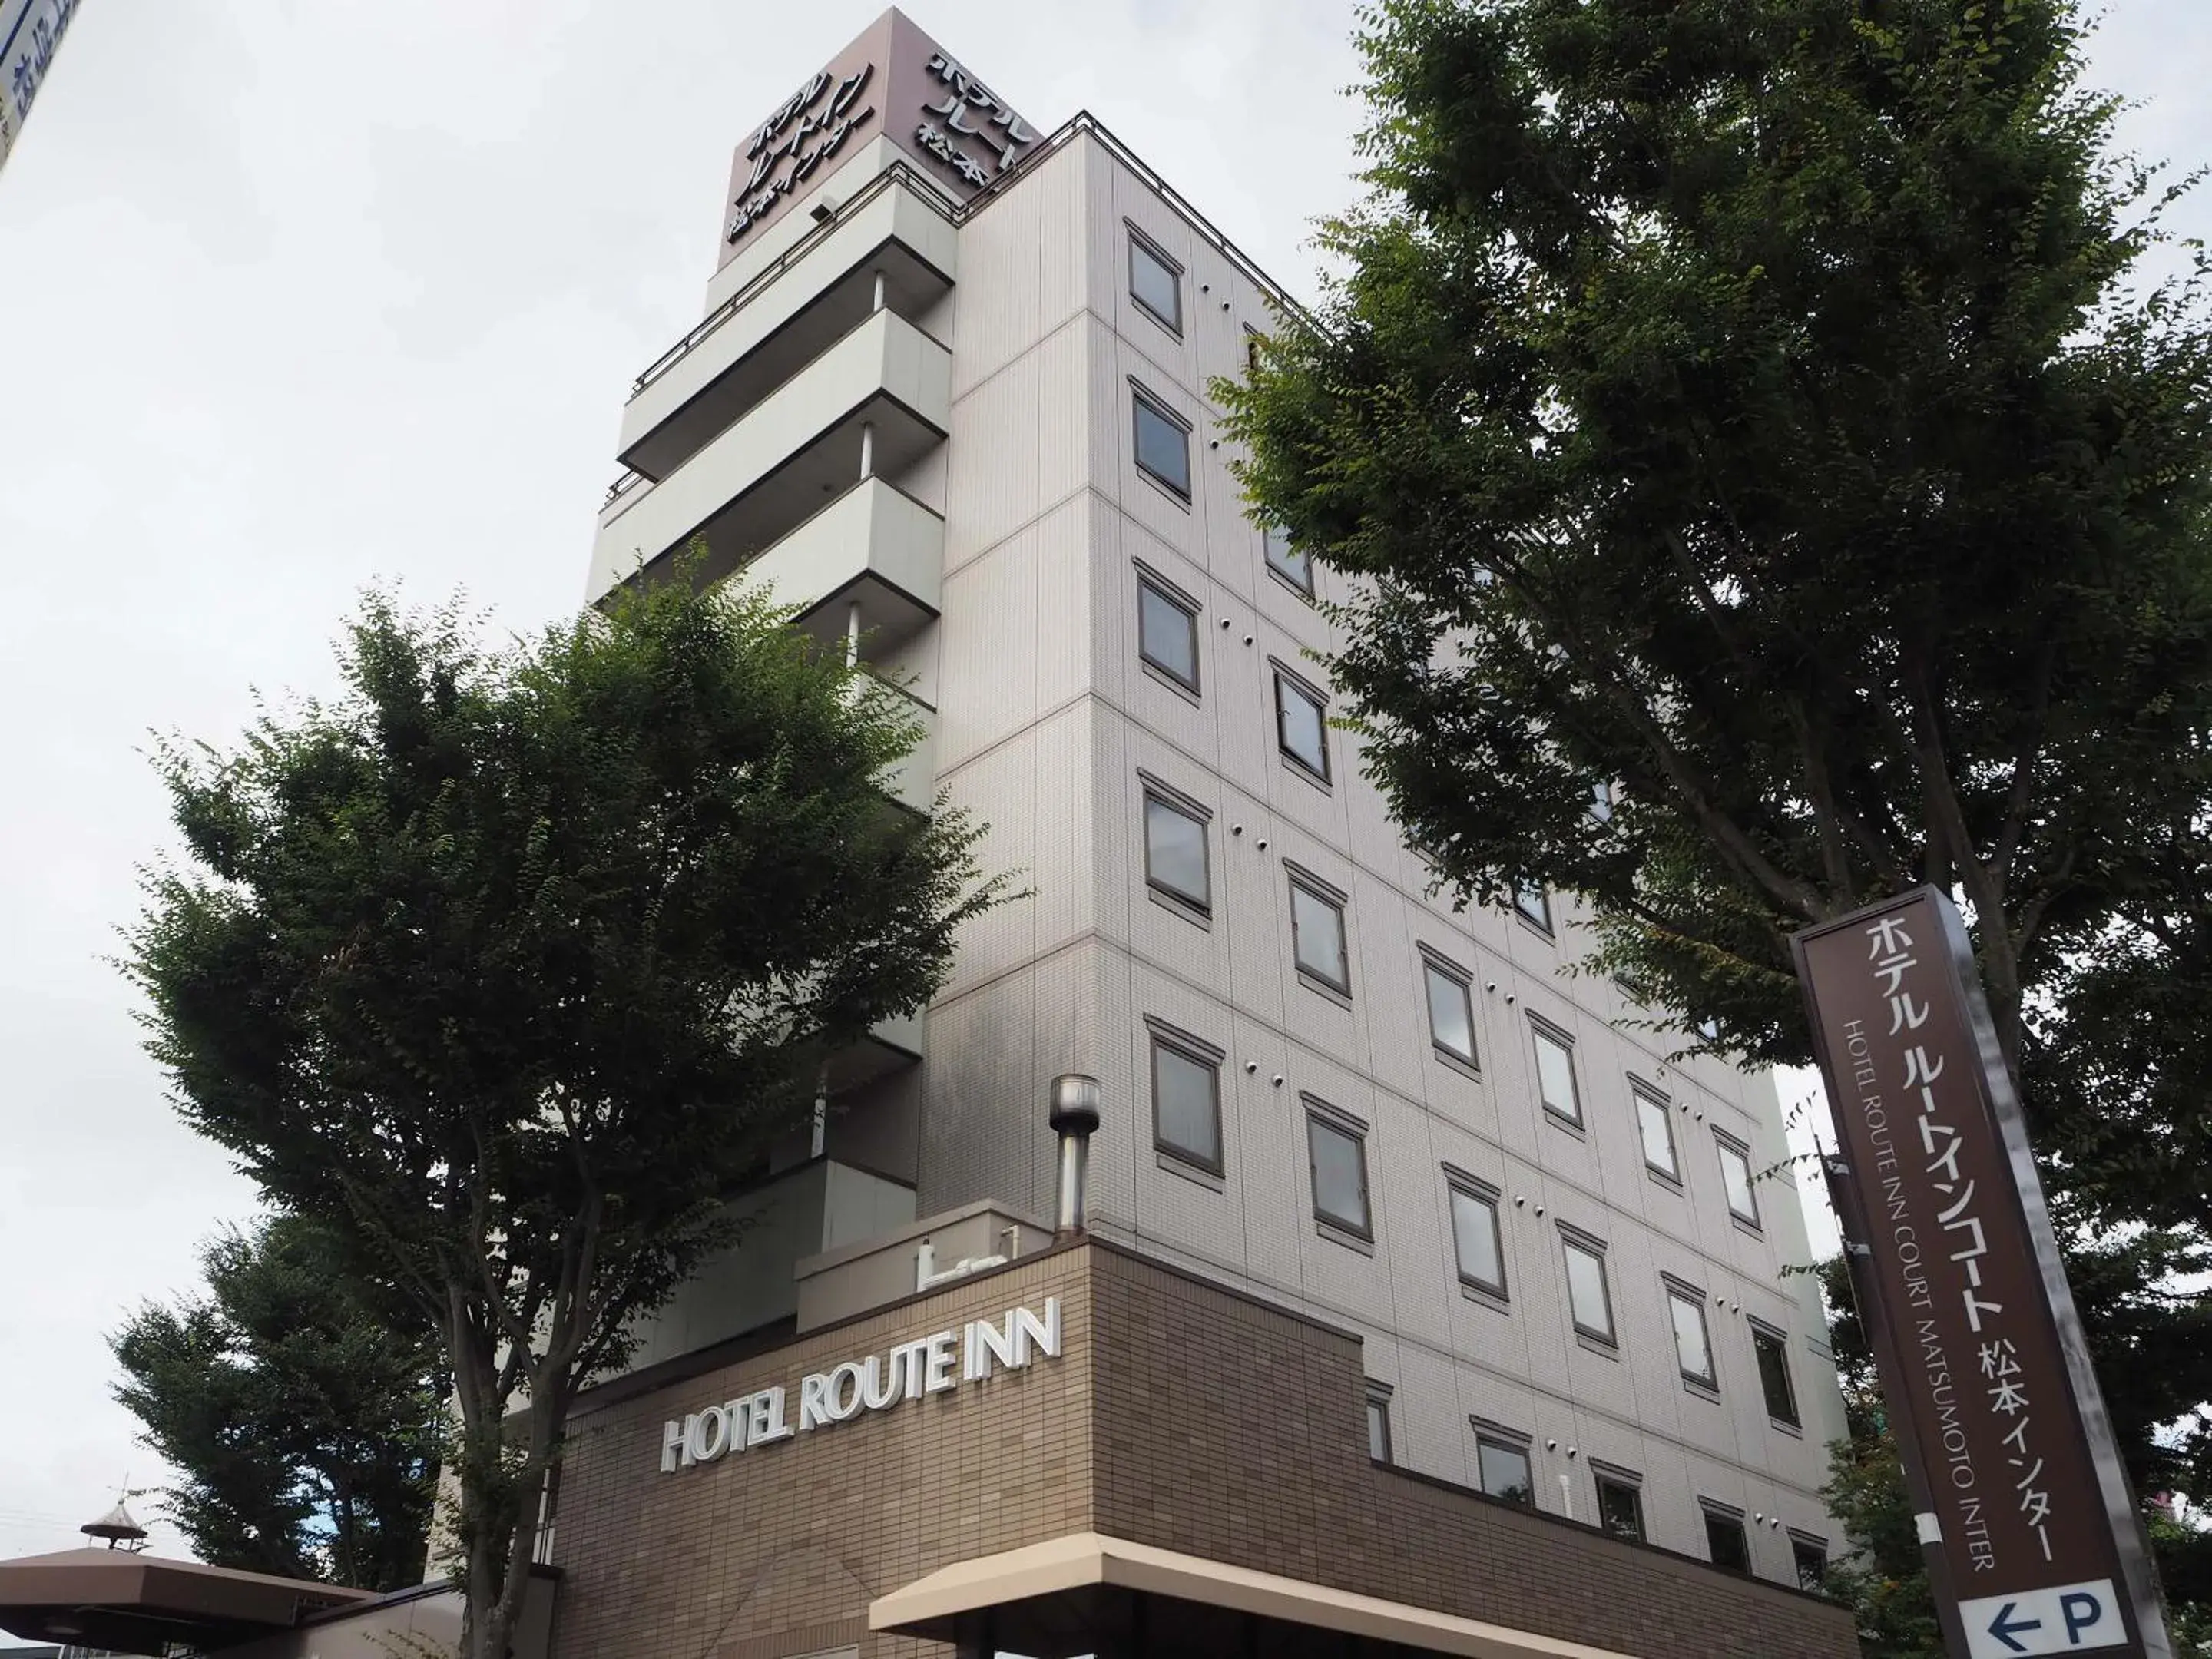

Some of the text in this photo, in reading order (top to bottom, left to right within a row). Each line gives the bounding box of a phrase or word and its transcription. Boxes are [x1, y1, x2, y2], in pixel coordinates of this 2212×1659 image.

[735, 62, 875, 206] ルートイン
[746, 72, 833, 159] ホテル
[915, 121, 989, 187] 松本
[926, 52, 1034, 143] ホテル
[1843, 1019, 1995, 1573] HOTEL ROUTE INN COURT MATSUMOTO INTER
[1866, 917, 2053, 1561] ホテル ルートインコート 松本インター
[661, 1296, 1061, 1472] HOTEL ROUTE INN
[2059, 1591, 2101, 1644] P
